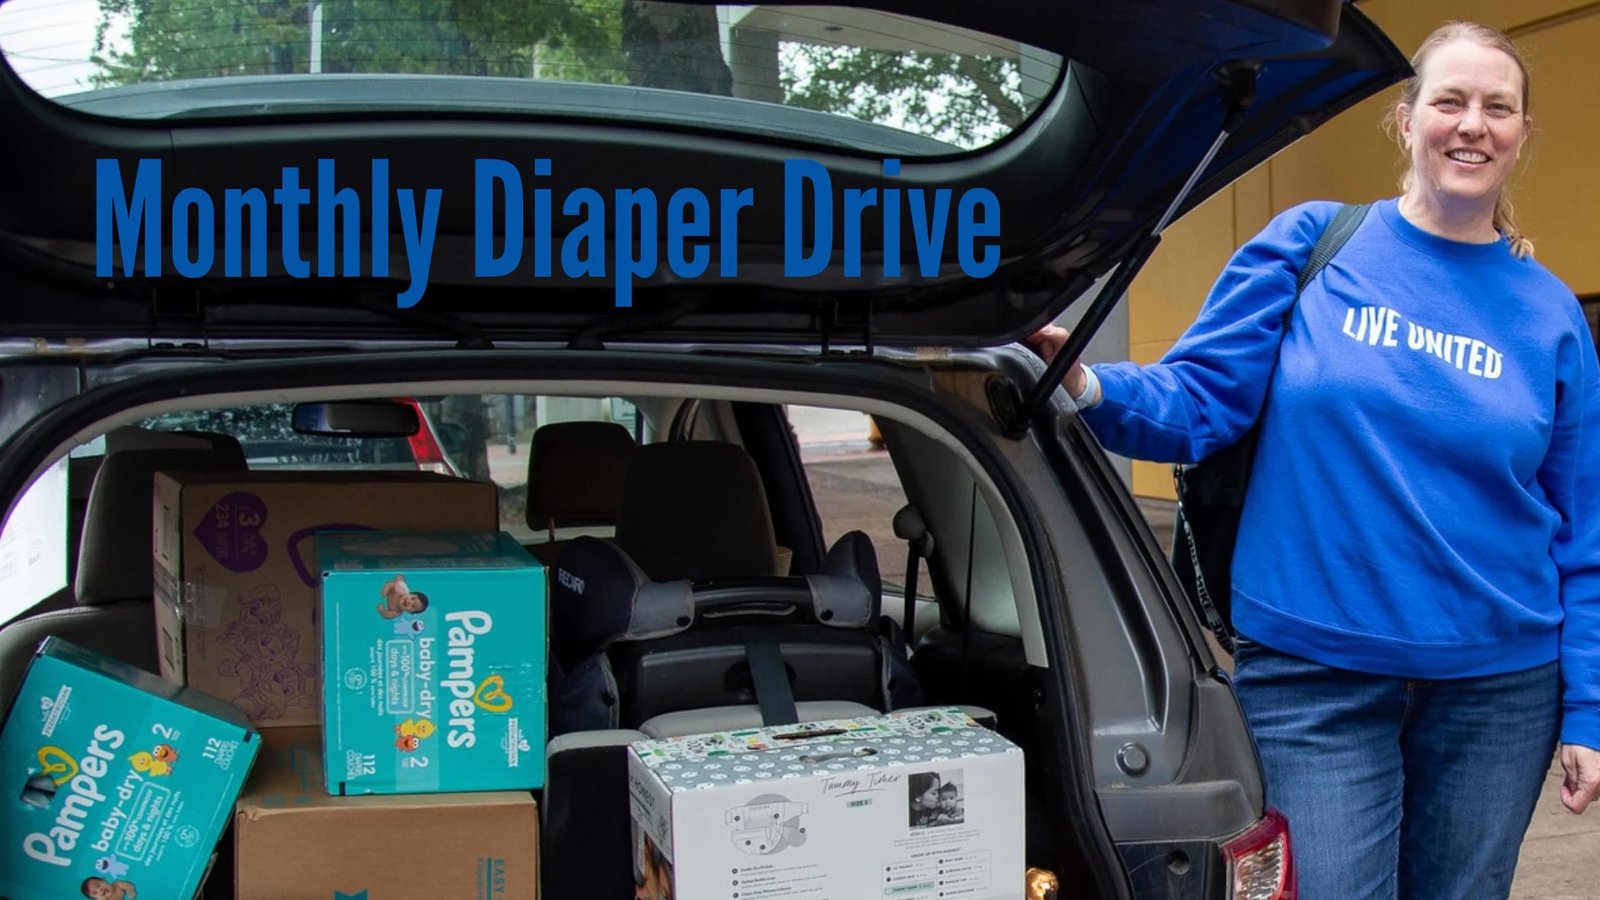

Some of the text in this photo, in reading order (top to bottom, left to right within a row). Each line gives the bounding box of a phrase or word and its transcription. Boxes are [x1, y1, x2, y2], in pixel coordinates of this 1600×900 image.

[1342, 306, 1503, 379] LIVE UNITED
[389, 648, 400, 669] days
[388, 679, 400, 706] nights
[415, 638, 436, 719] baby-dry
[440, 610, 493, 748] Pampers
[152, 723, 173, 740] 2
[202, 737, 222, 760] 112
[409, 756, 429, 768] 2
[362, 754, 376, 776] 112
[869, 770, 902, 788] Timer
[23, 724, 125, 867] Pampers
[91, 769, 144, 852] baby-dry
[132, 831, 148, 853] days
[147, 795, 164, 823] nights
[495, 858, 505, 894] EASY
